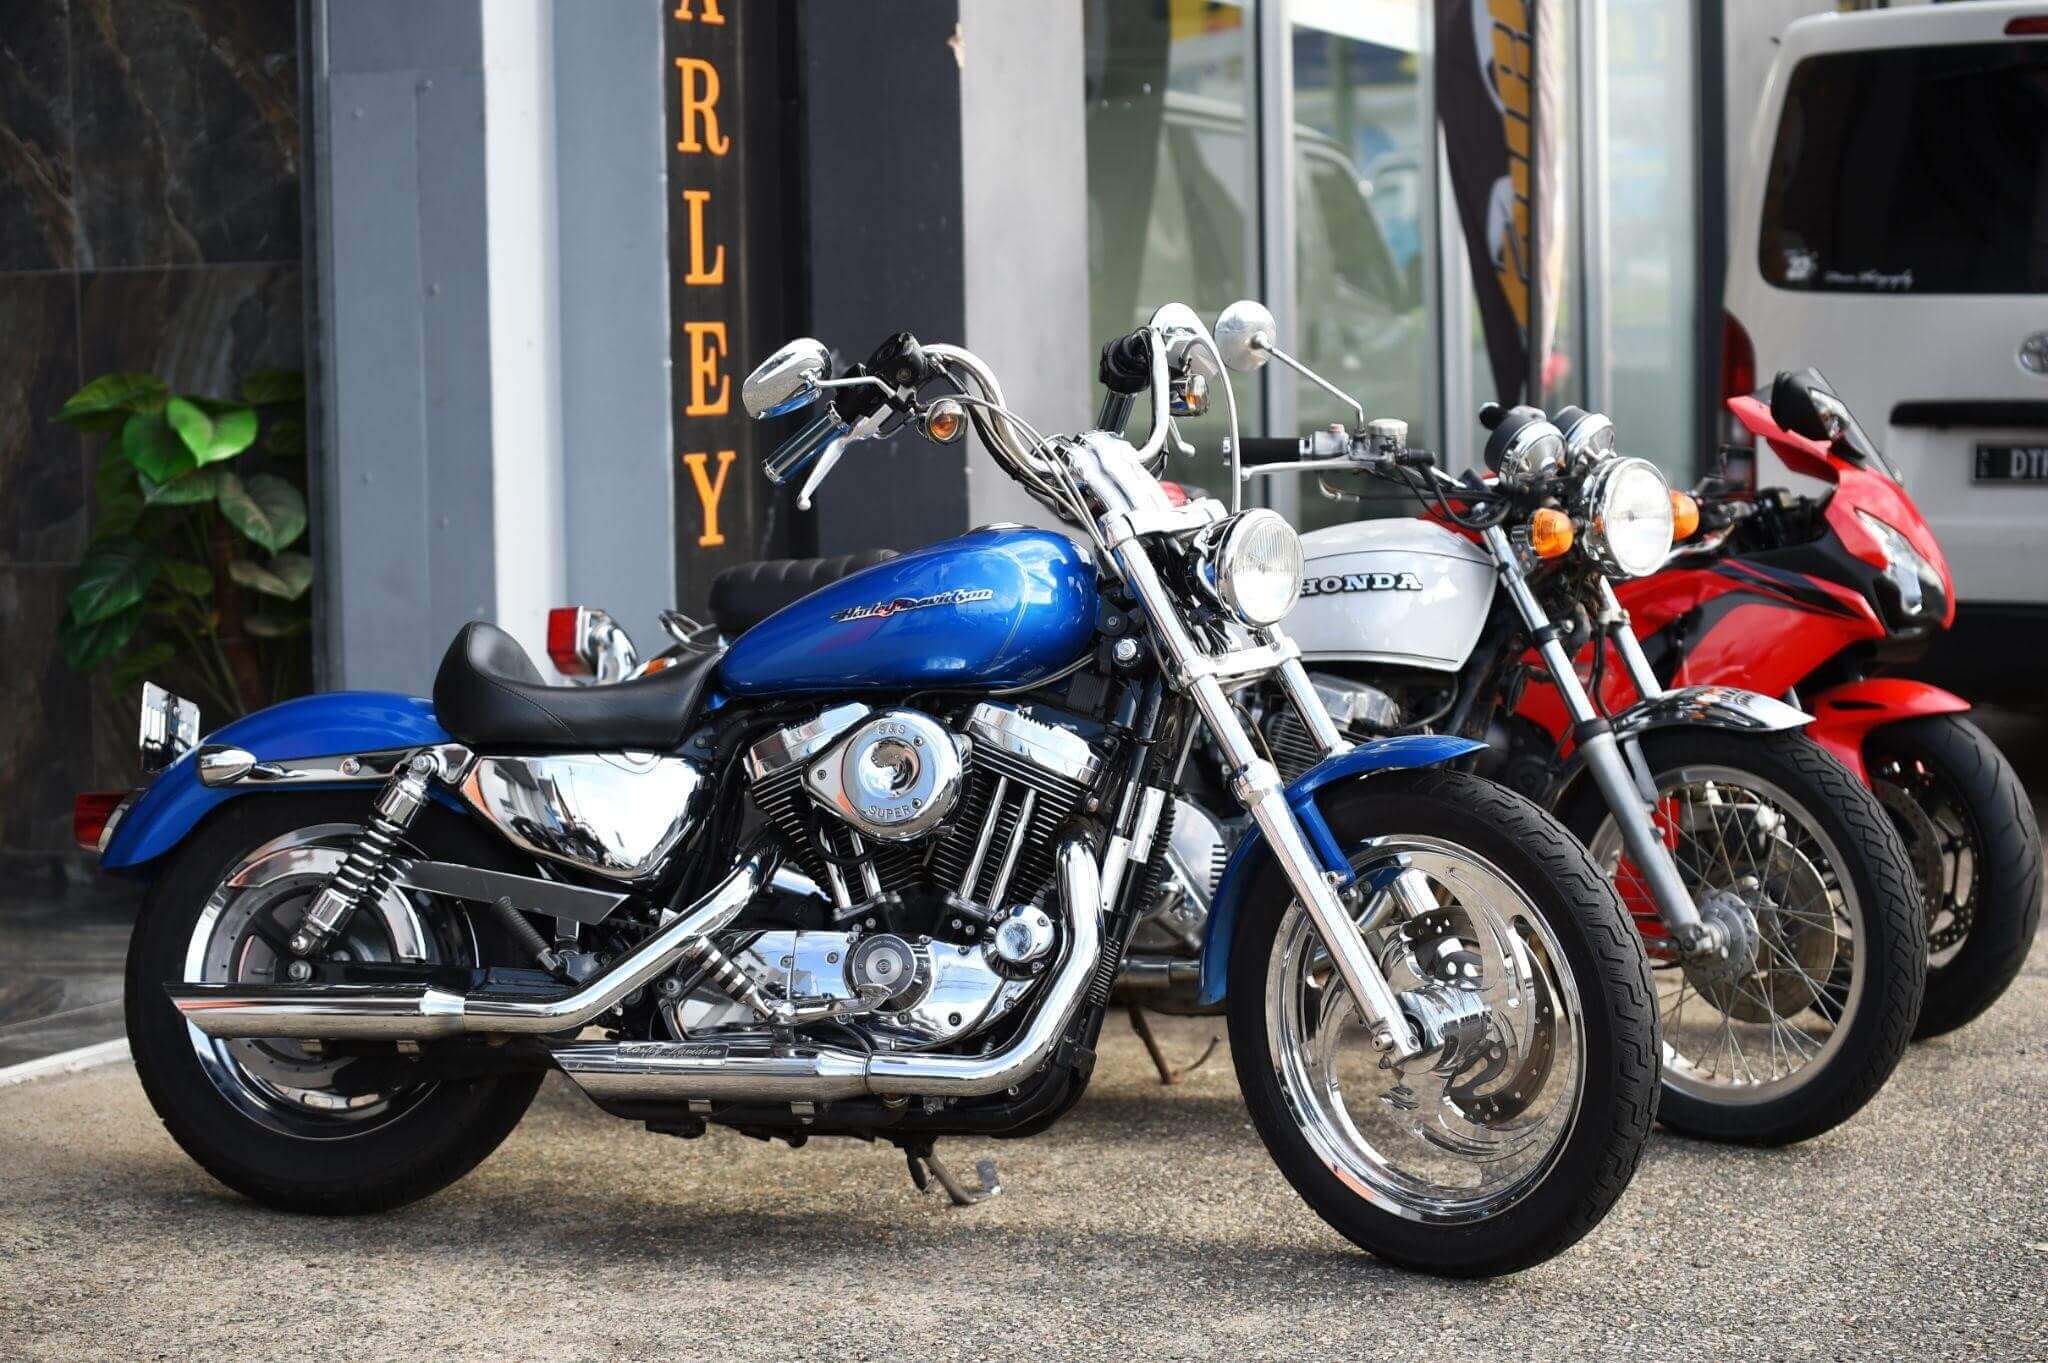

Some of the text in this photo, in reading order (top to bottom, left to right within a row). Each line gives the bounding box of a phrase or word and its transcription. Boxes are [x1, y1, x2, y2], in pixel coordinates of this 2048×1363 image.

[674, 0, 736, 547] RLEY
[1300, 572, 1423, 597] HONDA
[868, 804, 911, 819] SUPER
